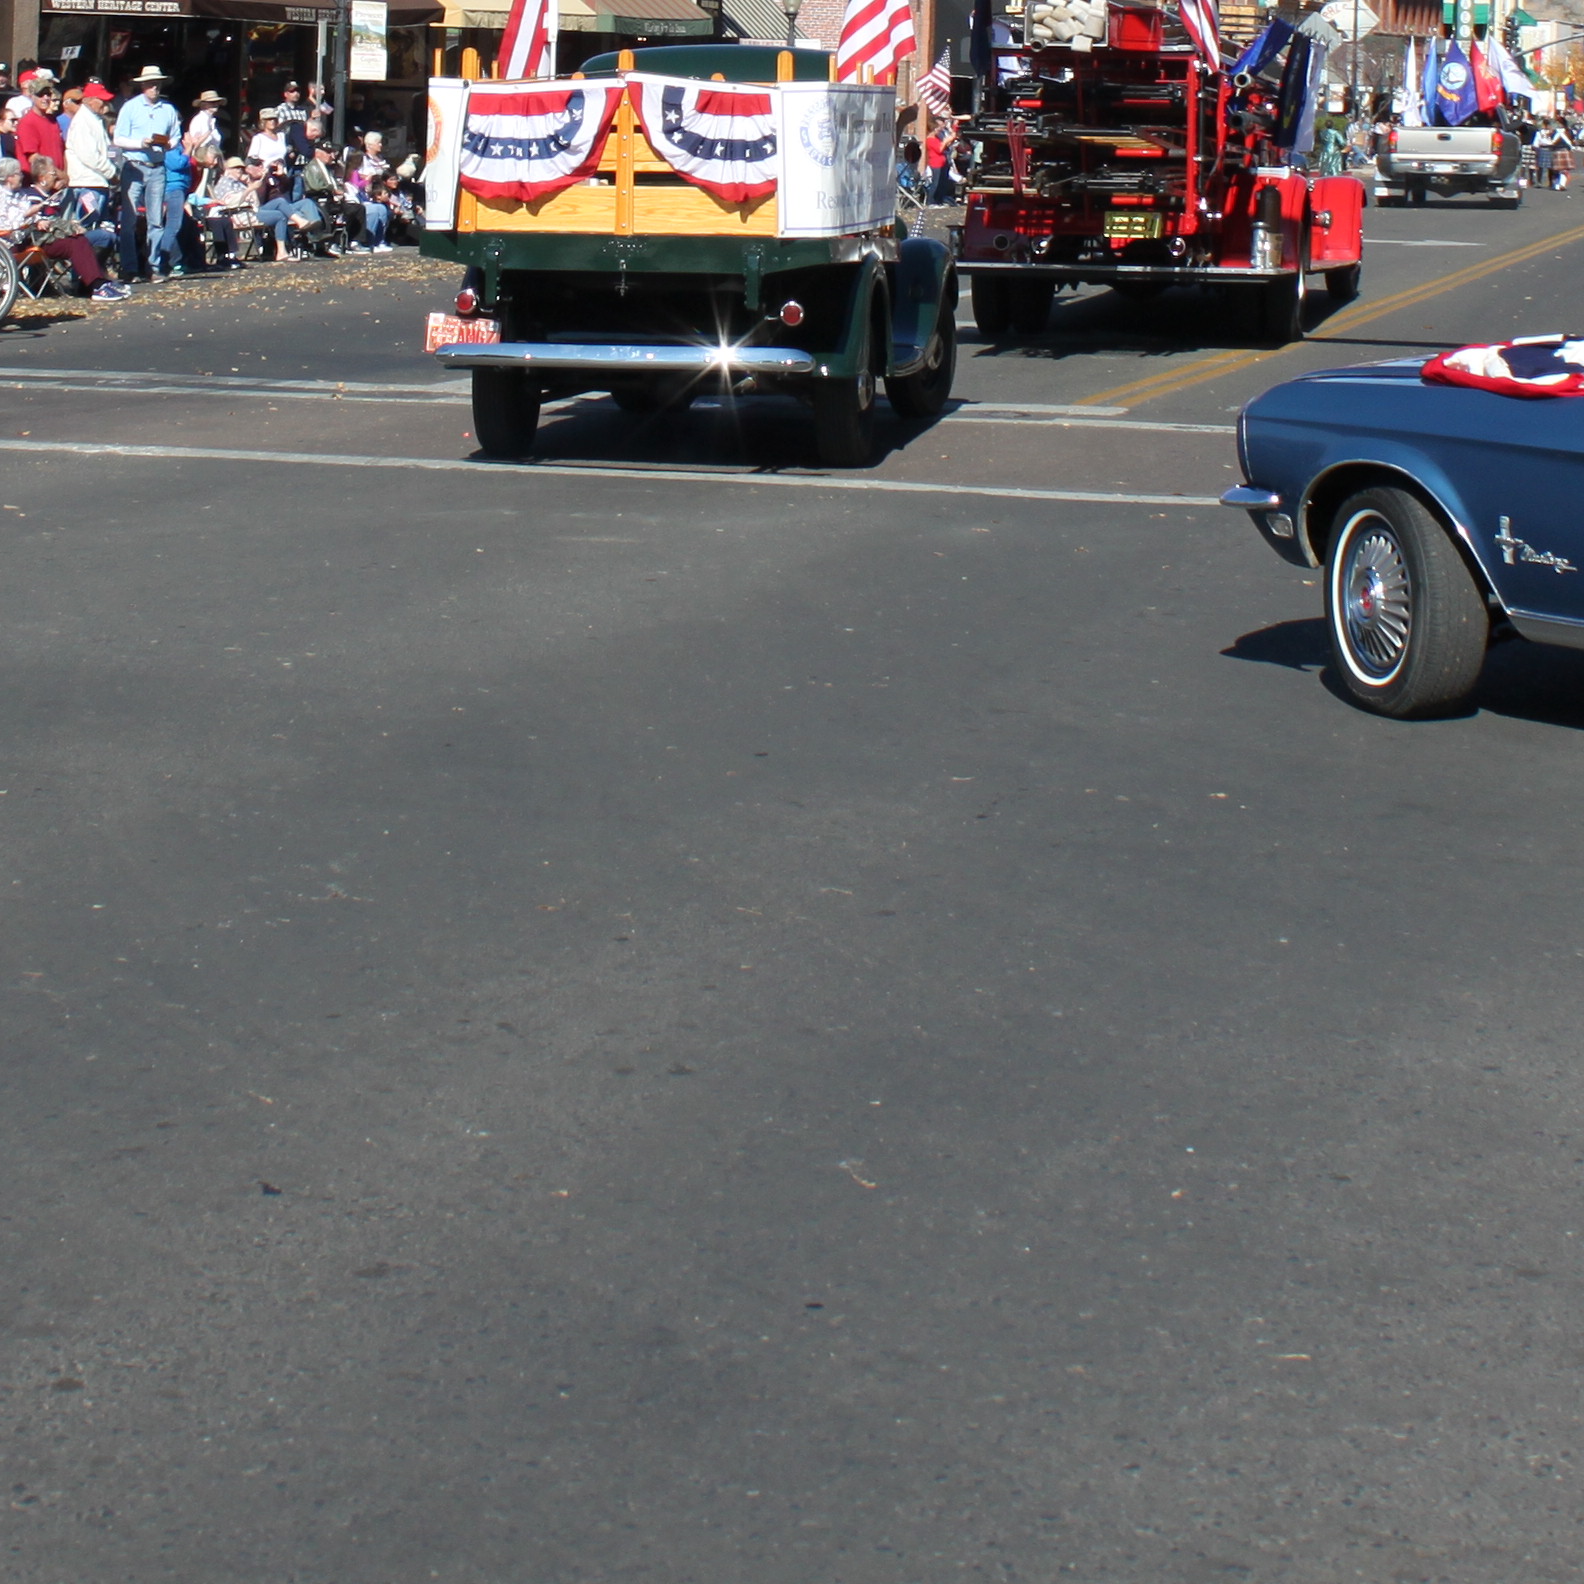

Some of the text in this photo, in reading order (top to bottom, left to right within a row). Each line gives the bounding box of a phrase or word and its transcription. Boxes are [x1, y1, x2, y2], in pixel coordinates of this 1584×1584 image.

[51, 0, 181, 13] WESTERN HERITAGE CENTER
